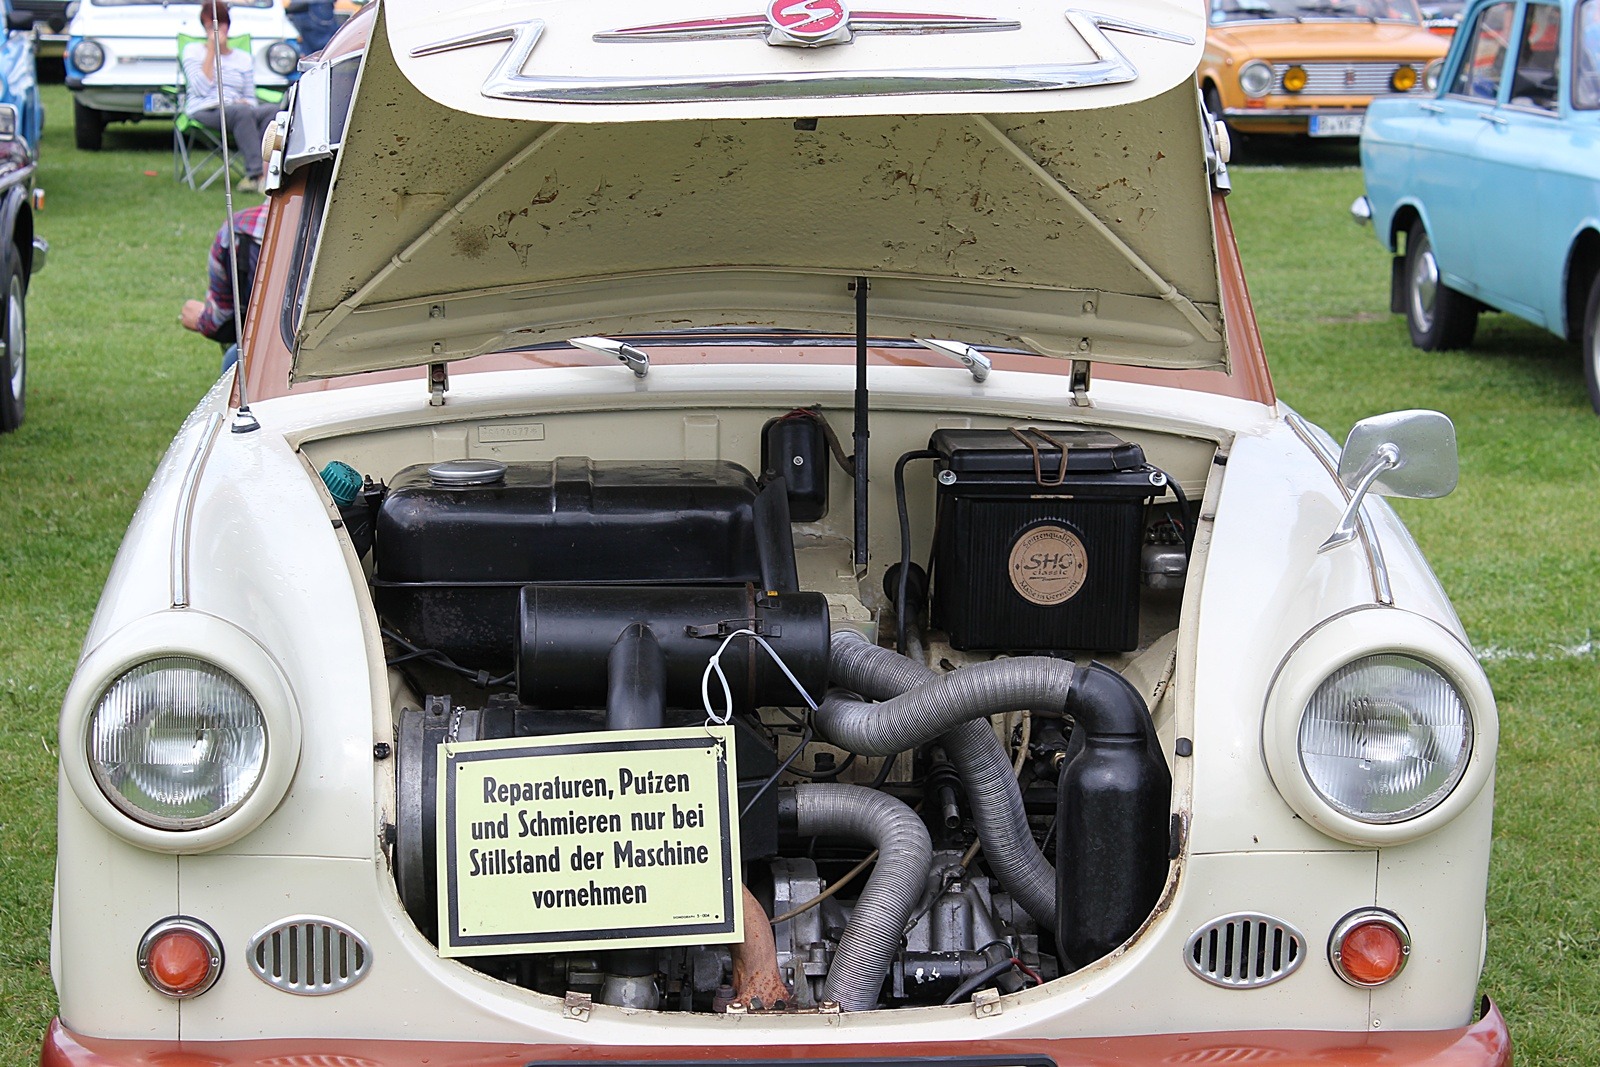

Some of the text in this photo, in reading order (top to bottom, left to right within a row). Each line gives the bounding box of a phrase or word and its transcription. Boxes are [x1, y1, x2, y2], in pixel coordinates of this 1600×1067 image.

[1020, 580, 1037, 597] Made
[1046, 580, 1080, 600] Germany
[483, 768, 690, 806] Reparaturen, Putzen
[471, 804, 704, 840] und Schmieren nur bei
[469, 840, 709, 877] Stillstand der Maschine
[532, 880, 647, 909] vornehmen
